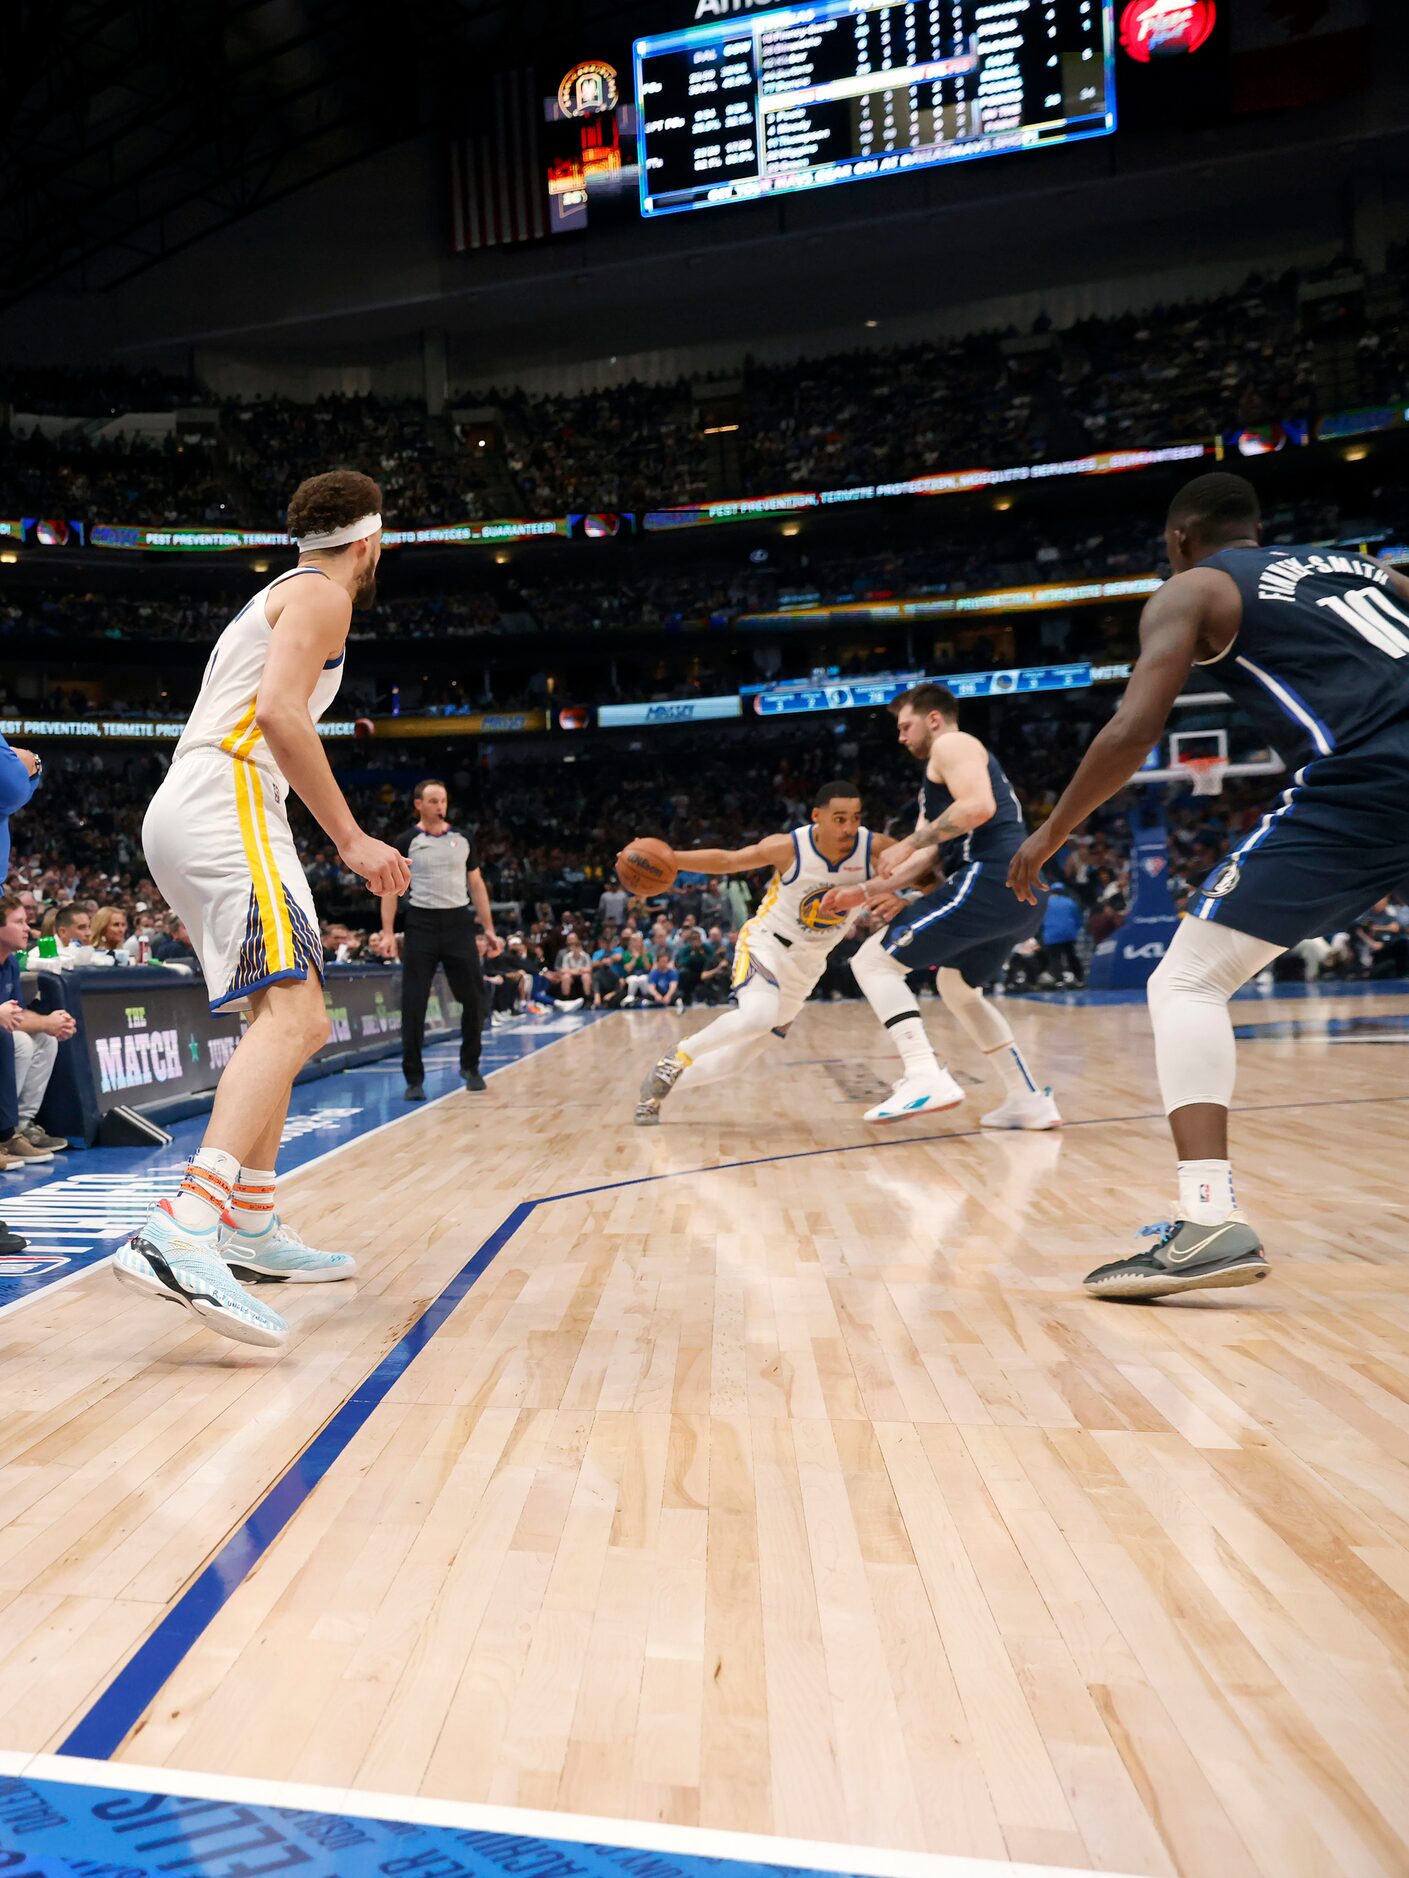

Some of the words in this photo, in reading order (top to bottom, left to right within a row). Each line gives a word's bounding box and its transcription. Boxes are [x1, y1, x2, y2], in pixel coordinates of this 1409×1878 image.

[145, 532, 172, 546] PEST
[172, 532, 243, 547] PREVENTION,
[243, 532, 291, 546] TERMITE
[416, 526, 472, 543] SERVICES
[481, 521, 557, 538] GUARANTEED!
[1315, 585, 1409, 659] 10
[23, 719, 102, 736] PREVENTION,
[102, 721, 154, 737] TERMITE
[125, 1007, 147, 1029] THE
[95, 1029, 183, 1093] MATCH
